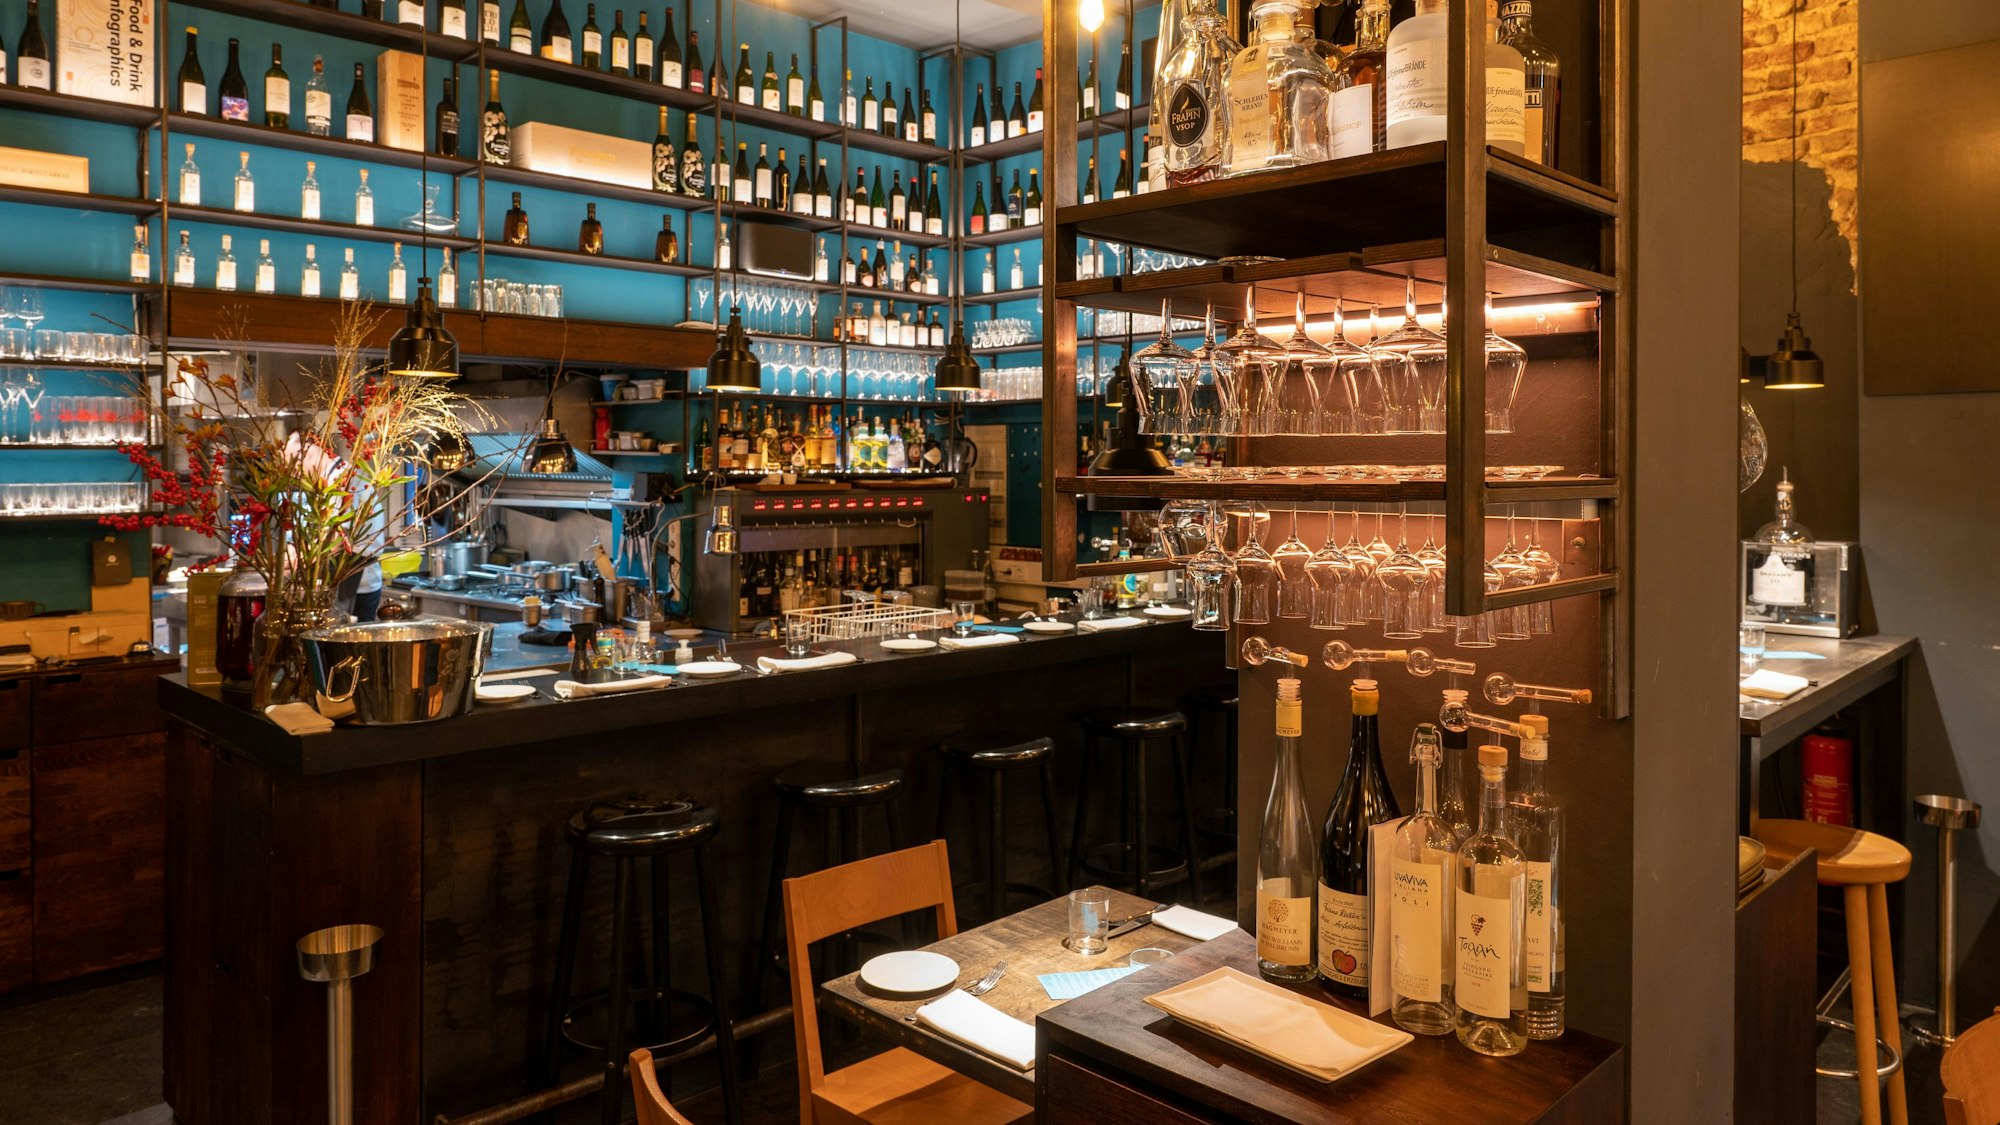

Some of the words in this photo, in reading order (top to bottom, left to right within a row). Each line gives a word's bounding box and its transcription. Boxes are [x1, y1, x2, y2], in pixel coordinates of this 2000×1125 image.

[129, 0, 143, 34] Food
[129, 37, 143, 48] &
[129, 52, 143, 92] Drink
[1234, 93, 1268, 107] SCHLEHEN
[1241, 102, 1263, 111] BRAND
[1171, 109, 1201, 125] FRAPIN
[1176, 121, 1195, 132] VSOP
